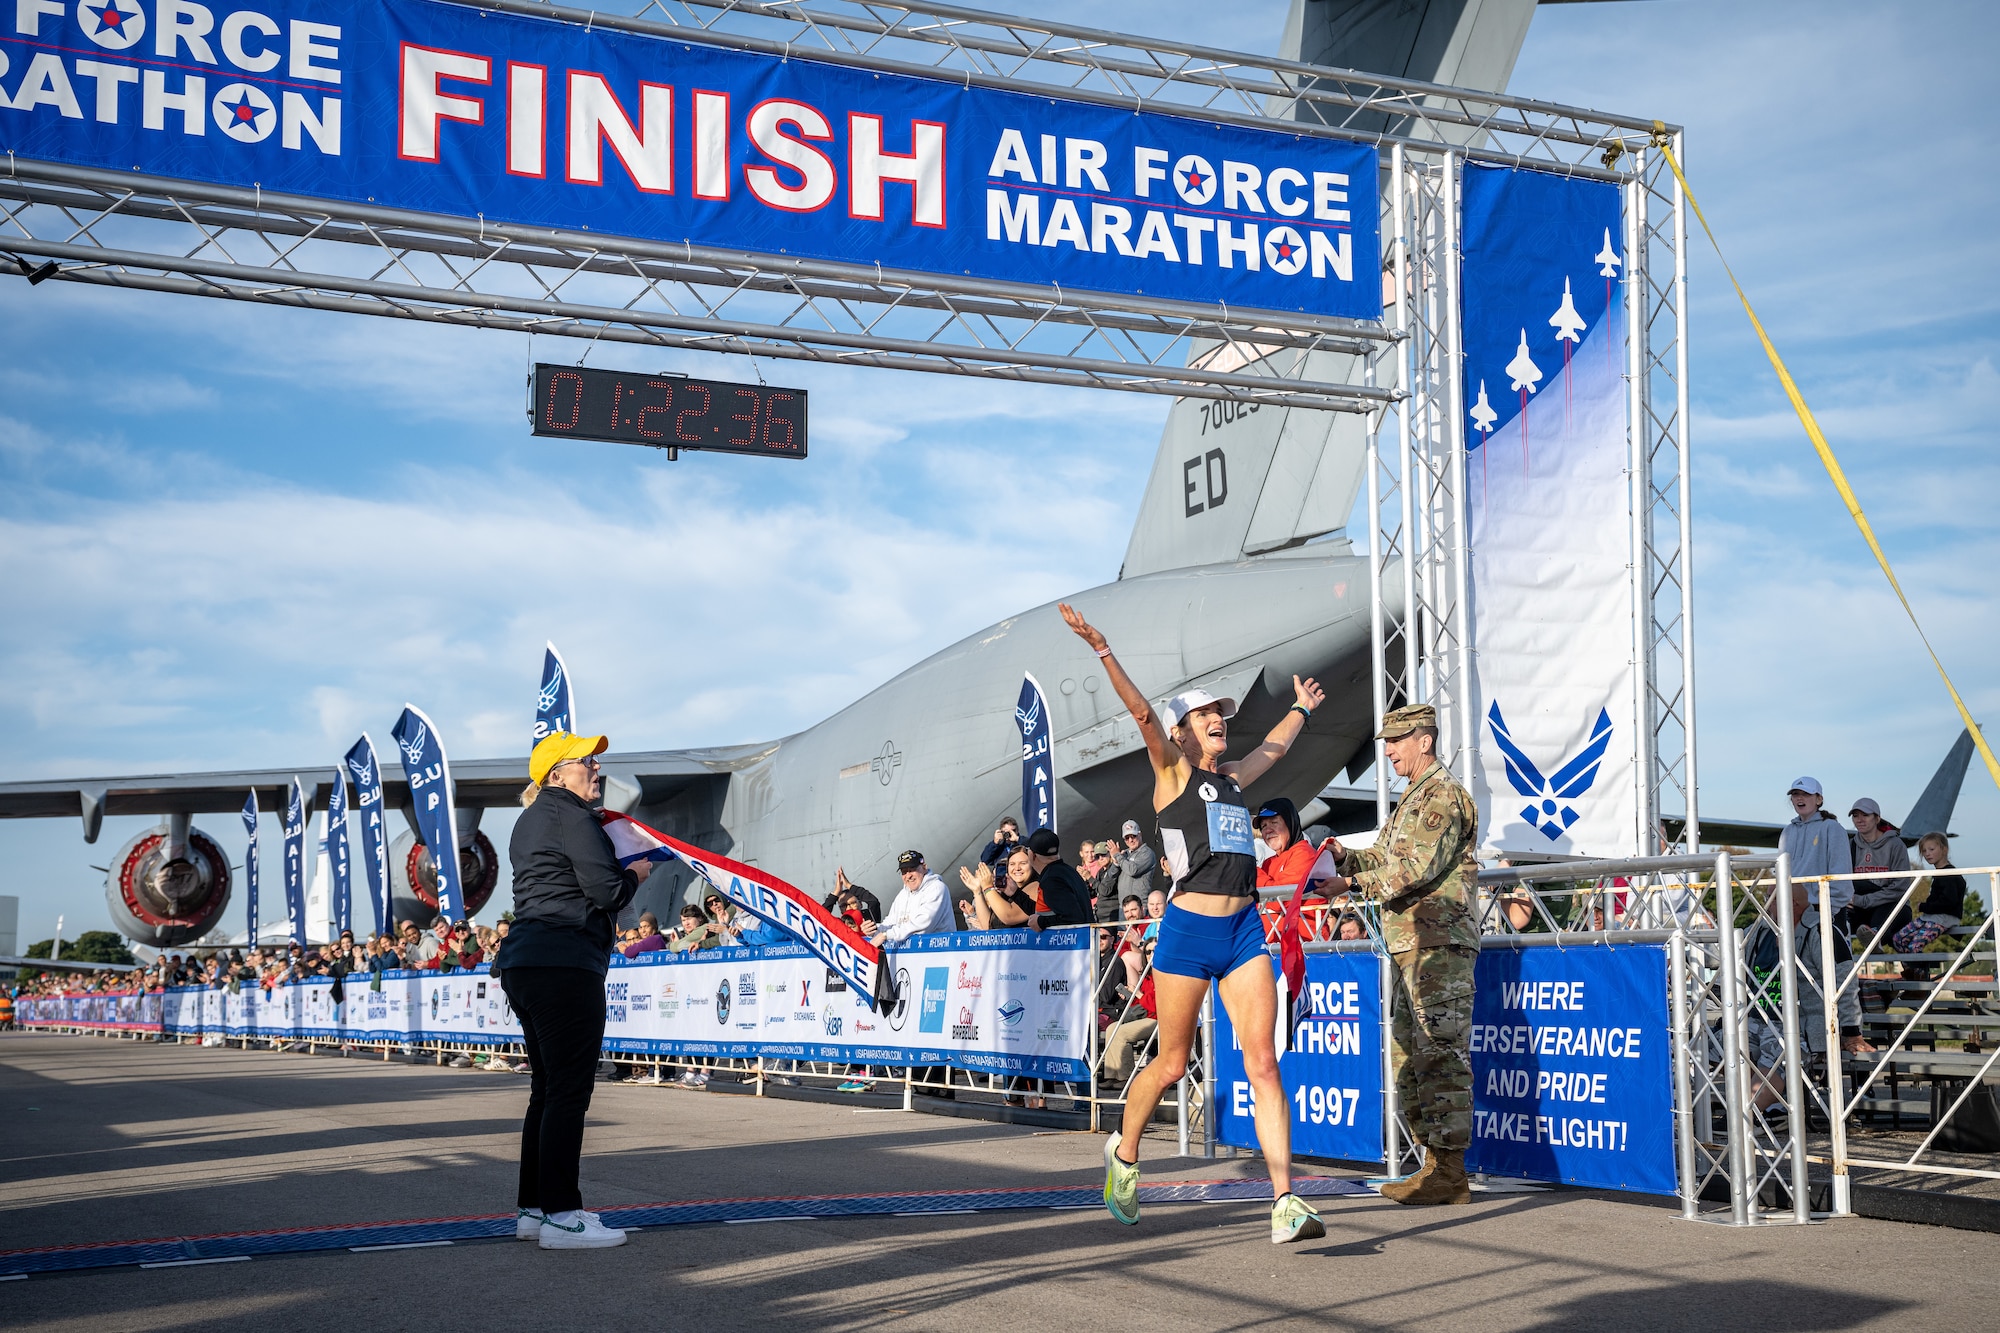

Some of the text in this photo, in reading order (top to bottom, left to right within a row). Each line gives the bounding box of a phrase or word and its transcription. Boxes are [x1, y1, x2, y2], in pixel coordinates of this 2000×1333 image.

[397, 40, 946, 230] FINISH
[988, 127, 1351, 223] AIR FORCE
[986, 189, 1353, 282] MARATHON
[1183, 447, 1228, 518] ED
[729, 876, 779, 919] AIR
[785, 899, 868, 988] FORCE
[968, 933, 1028, 946] USAFMARATHON.COM
[1048, 932, 1078, 946] #FLYAFM
[1051, 980, 1069, 992] HOIST
[1502, 981, 1585, 1011] WHERE
[793, 1012, 816, 1021] EXCHANGE
[826, 1016, 843, 1036] KBR
[959, 1006, 974, 1025] City
[1469, 1025, 1642, 1058] ERSEVERANCE
[1486, 1068, 1608, 1104] AND PRIDE
[1295, 1085, 1360, 1127] 1997
[1474, 1110, 1628, 1152] TAKE FLIGHT!
